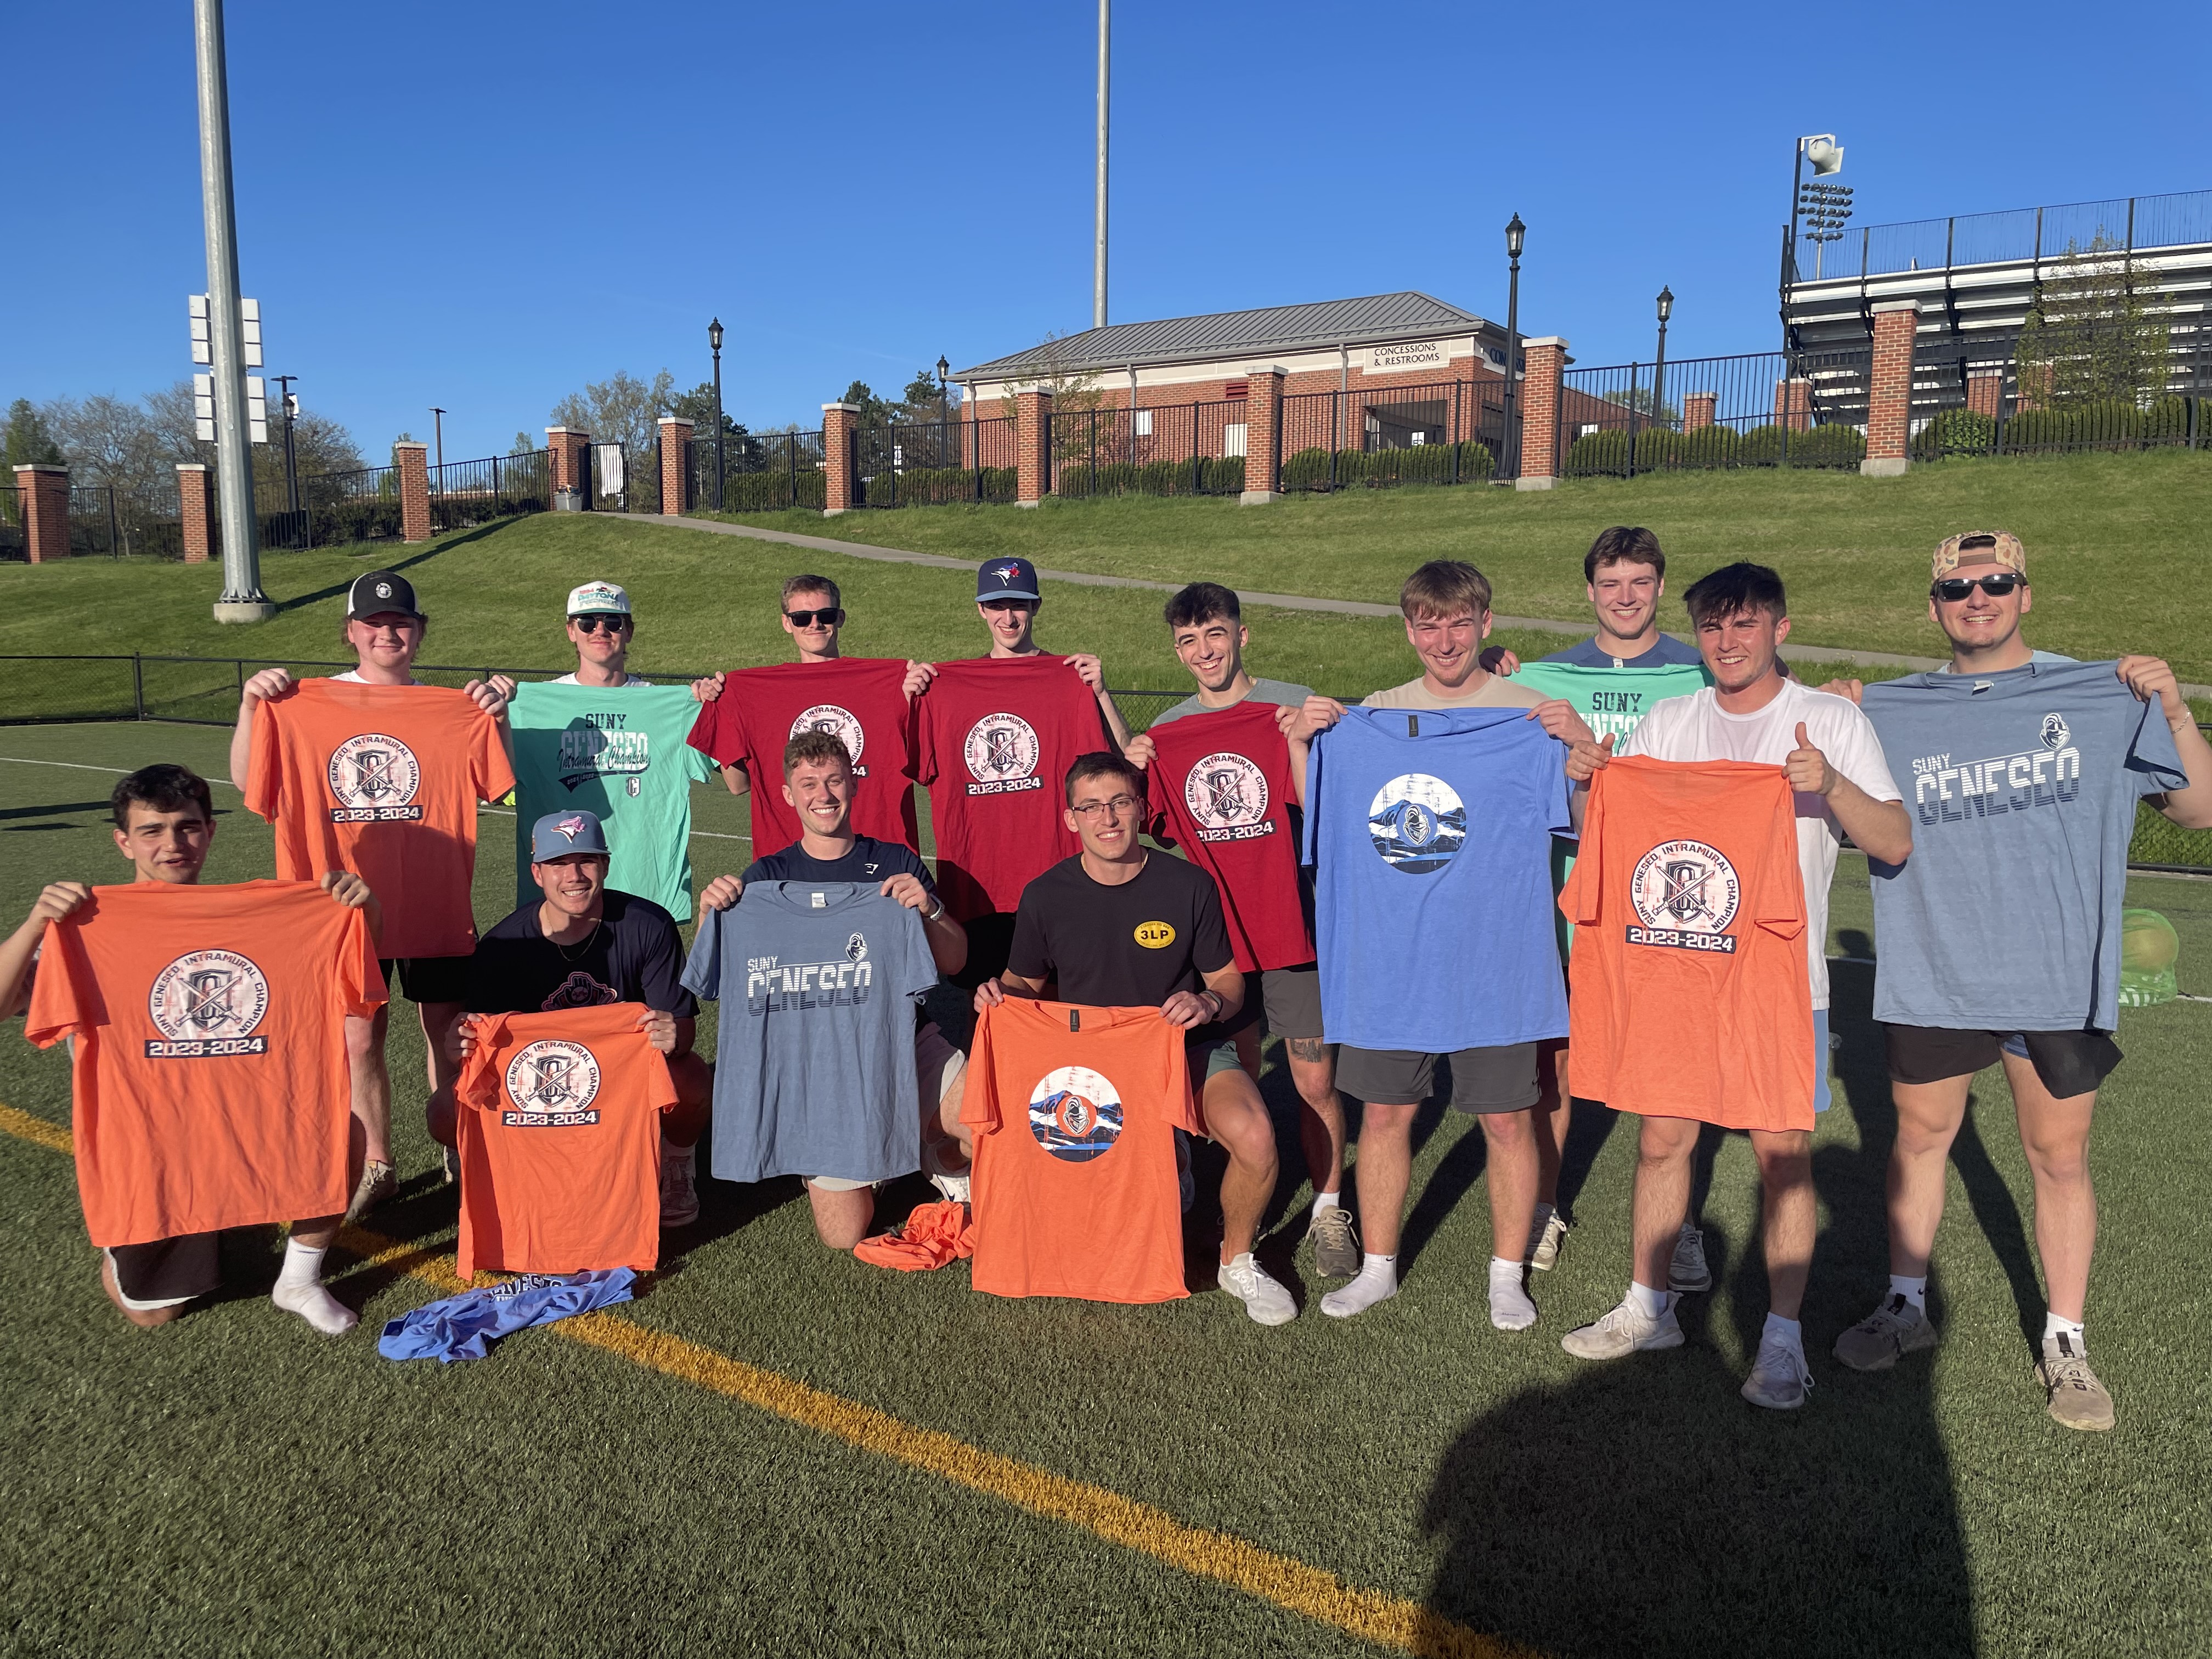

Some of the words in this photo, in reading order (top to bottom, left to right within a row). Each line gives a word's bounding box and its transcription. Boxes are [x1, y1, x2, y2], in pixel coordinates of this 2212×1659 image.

[1374, 343, 1436, 356] CONCESSIONS
[1374, 358, 1381, 366] &
[1385, 353, 1440, 365] RESTROOMS
[1592, 692, 1642, 712] SUNY
[585, 713, 627, 729] SUNY
[806, 707, 854, 724] INTRAMURAL
[983, 715, 1030, 733] INTRAMURAL
[351, 737, 408, 758] INTRAMURAL
[561, 731, 648, 771] GENESEO
[967, 726, 981, 758] GENESEO
[331, 747, 348, 781] GENESEO
[1023, 736, 1037, 775] CHAMPION
[1201, 755, 1255, 774] INTRAMURAL
[1912, 753, 1950, 775] SUNY
[399, 761, 417, 803] CHAMPION
[969, 763, 985, 780] SUNY
[335, 787, 353, 805] SUNY
[968, 777, 1041, 795] 2023-2024
[1188, 769, 1200, 802] GENESEO
[1915, 747, 2079, 826] GENESEO
[1251, 776, 1266, 821] CHAMPION
[334, 807, 420, 822] 2023-2024
[1193, 808, 1210, 825] SUNY
[1662, 844, 1729, 875] INTRAMURAL
[1635, 853, 1659, 893] GENESEO
[1637, 900, 1656, 925] SUNY
[1711, 879, 1736, 930] CHAMPION
[1630, 928, 1733, 951] 2023-2024
[184, 953, 257, 979] INTRAMURAL
[747, 956, 778, 973] SUNY
[154, 966, 180, 1007] GENESEO
[748, 961, 872, 1017] GENESEO
[238, 982, 264, 1034] CHAMPION
[156, 1013, 178, 1037] SUNY
[149, 1038, 264, 1056] 2023-2024
[533, 1042, 591, 1064] INTRAMURAL
[509, 1052, 530, 1085] GENESEO
[511, 1090, 529, 1109] SUNY
[575, 1067, 597, 1109] CHAMPION
[506, 1111, 597, 1125] 2023-2024
